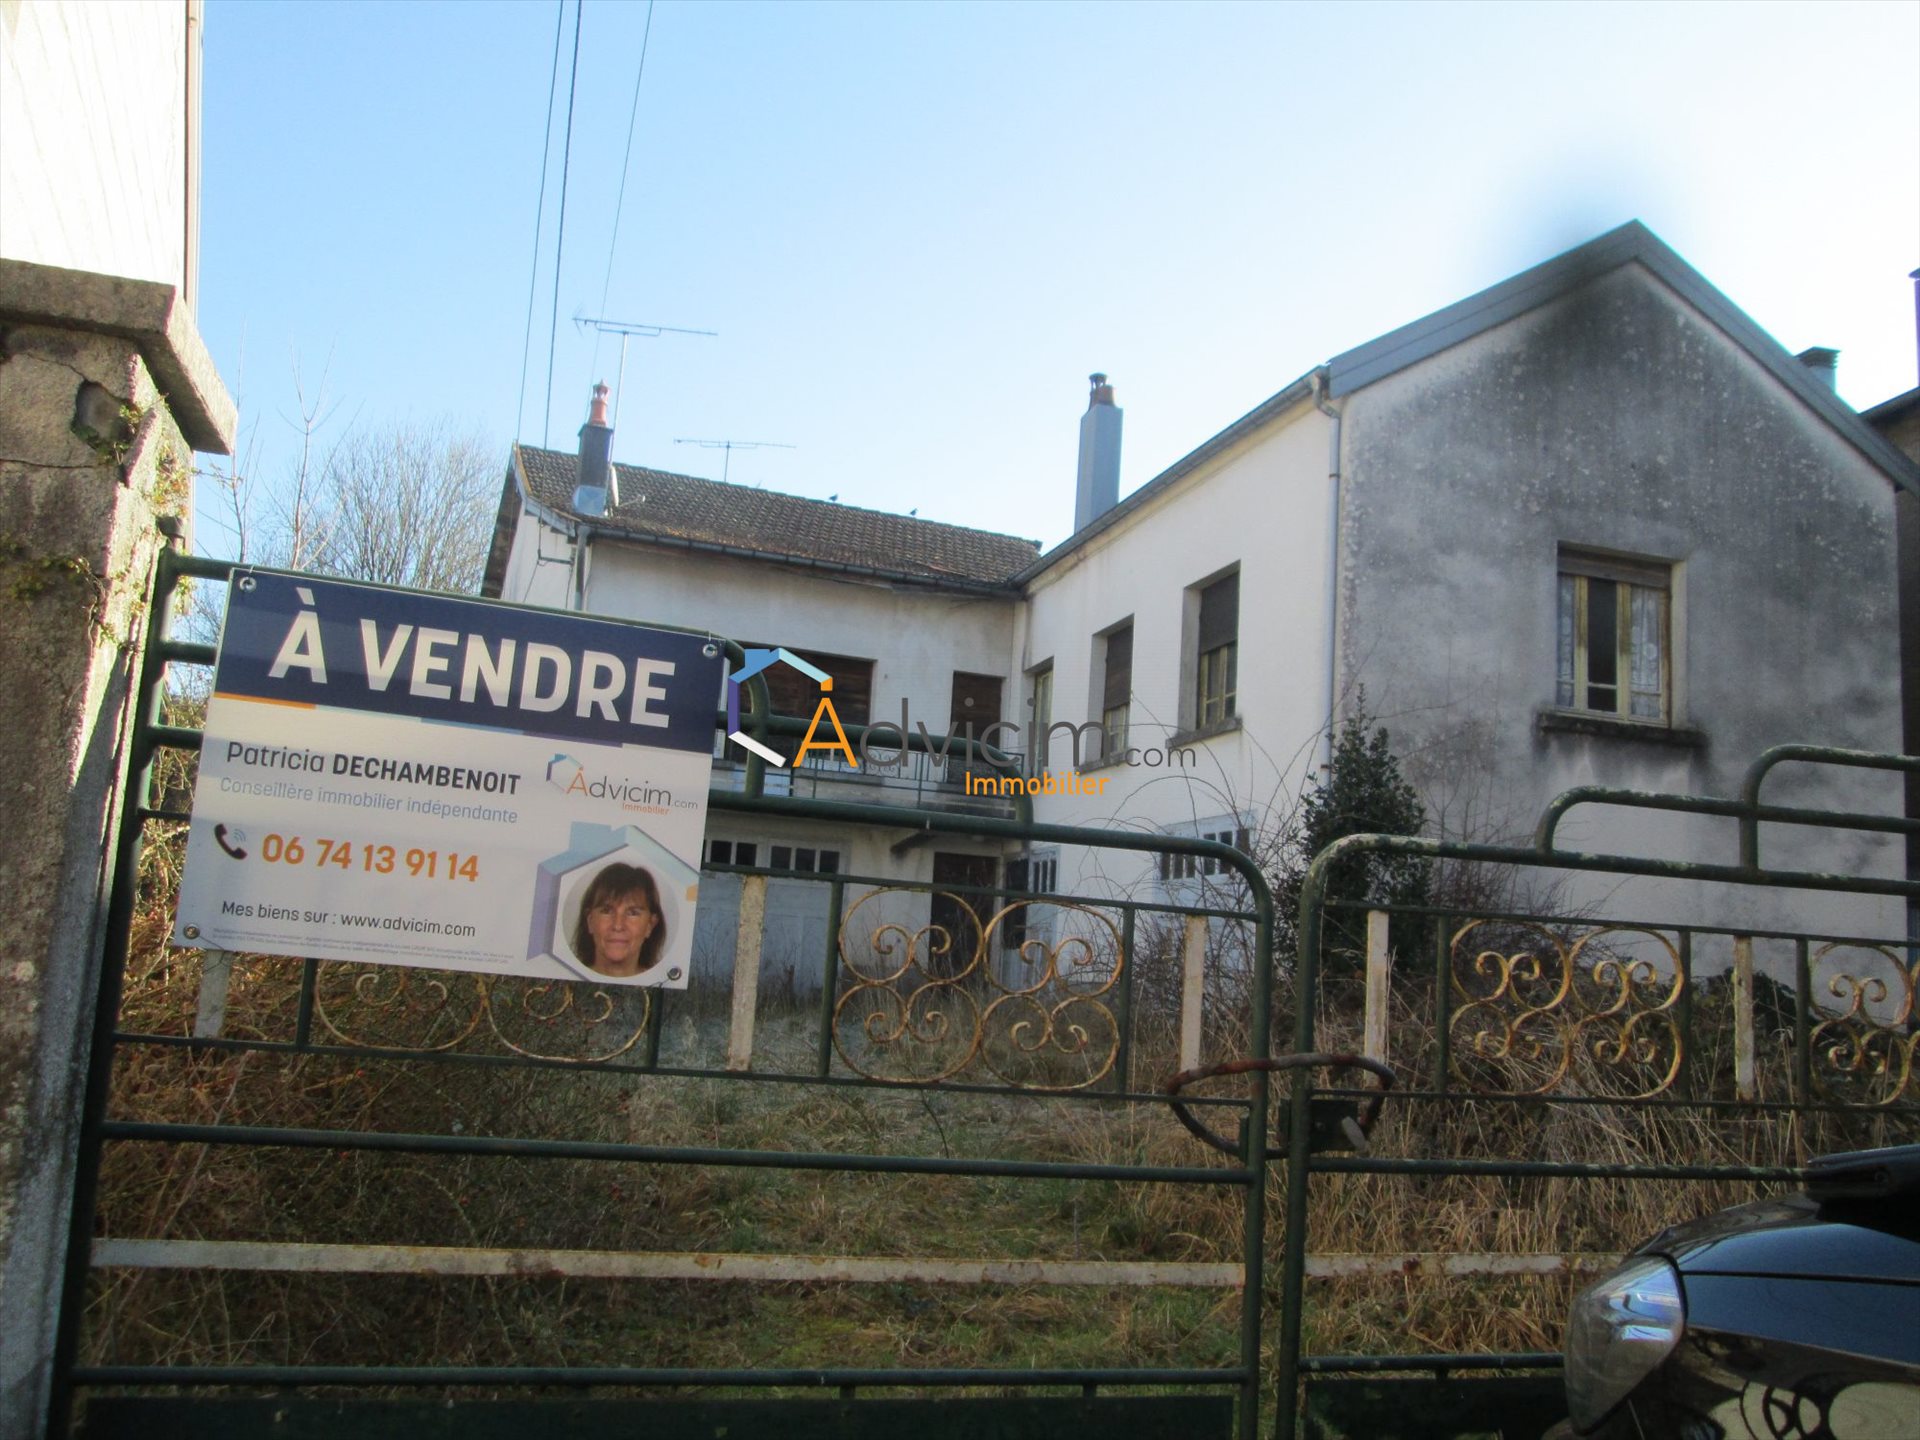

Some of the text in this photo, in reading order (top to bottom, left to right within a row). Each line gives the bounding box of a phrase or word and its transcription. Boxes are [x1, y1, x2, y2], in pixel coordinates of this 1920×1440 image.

[268, 587, 676, 728] À VENDRE
[227, 741, 521, 795] Patricia DECHAMBENOIT
[220, 776, 518, 824] Conseillère immobilier indépendante
[622, 801, 670, 816] Immobilier
[261, 833, 480, 882] 06 74 13 91 14
[221, 900, 254, 917] Mes
[258, 903, 299, 921] biens
[303, 910, 328, 924] sur
[340, 913, 476, 937] www.advicim.com
